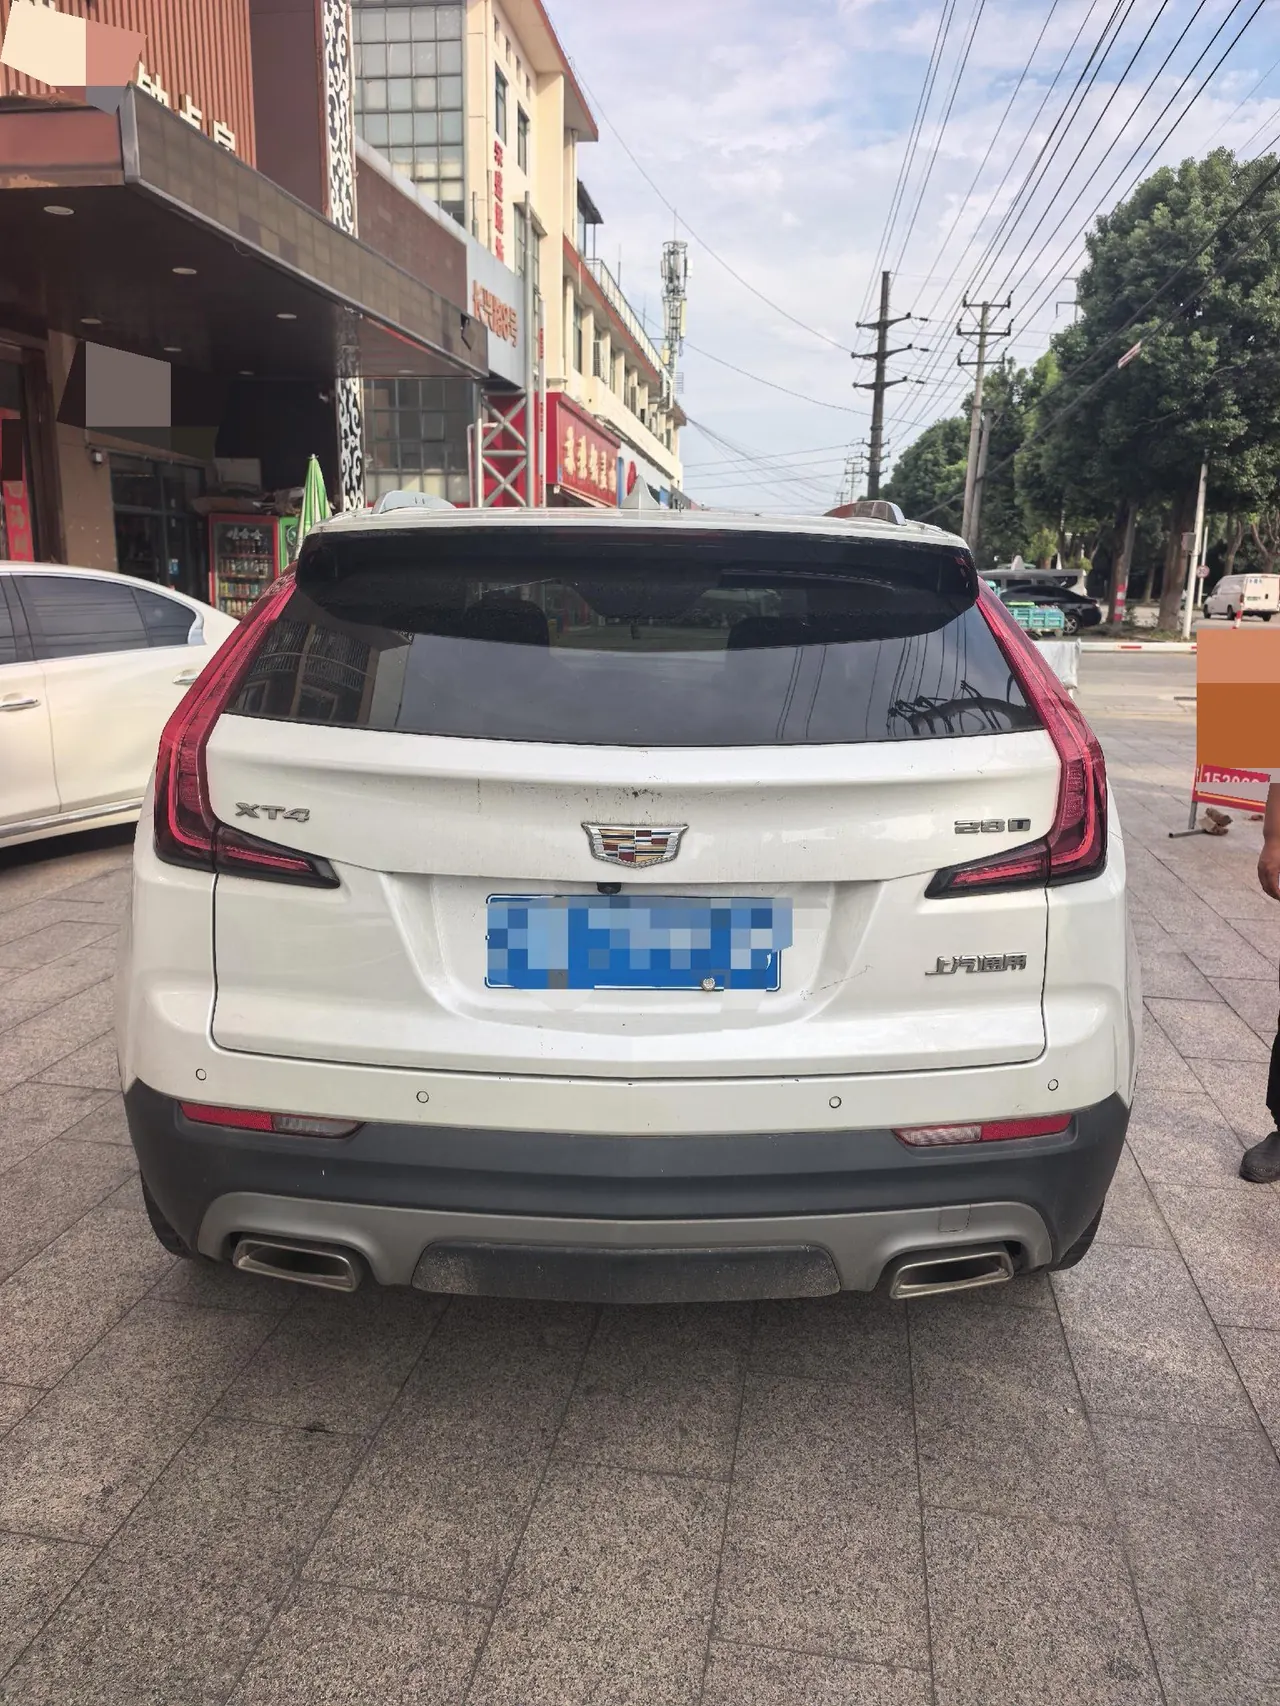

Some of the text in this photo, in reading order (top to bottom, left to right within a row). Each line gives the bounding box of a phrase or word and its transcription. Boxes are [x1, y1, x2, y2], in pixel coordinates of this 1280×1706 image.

[235, 802, 310, 822] XT4
[924, 952, 1027, 975] 上汽通用
